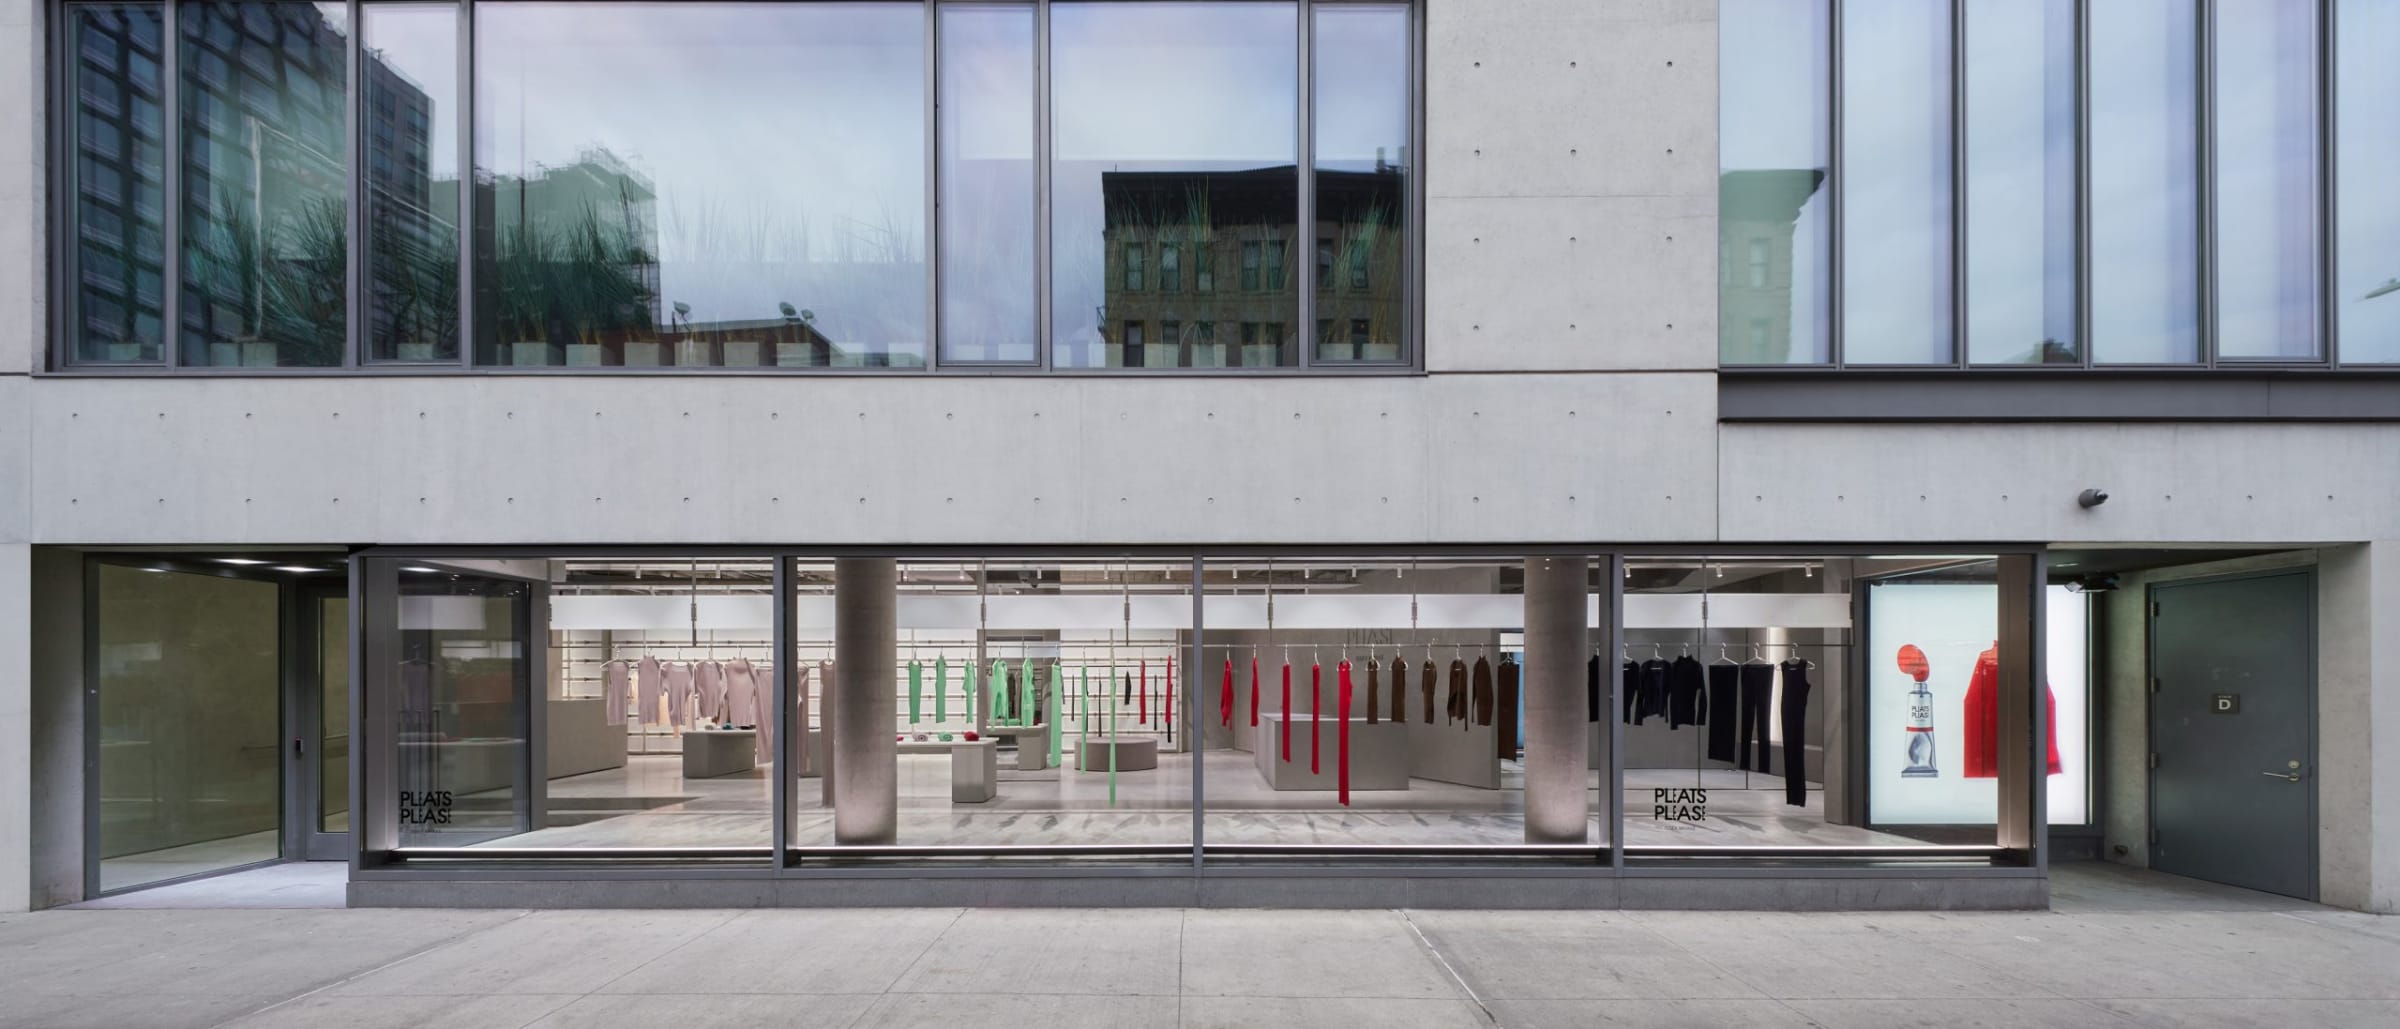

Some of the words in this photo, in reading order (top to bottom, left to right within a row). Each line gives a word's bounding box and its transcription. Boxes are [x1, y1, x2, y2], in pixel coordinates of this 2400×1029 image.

[2218, 699, 2231, 710] D
[400, 791, 452, 806] PLEATS
[1655, 788, 1707, 803] PLEATS
[400, 808, 452, 824] PLEASE
[1655, 805, 1706, 821] PLEASE
